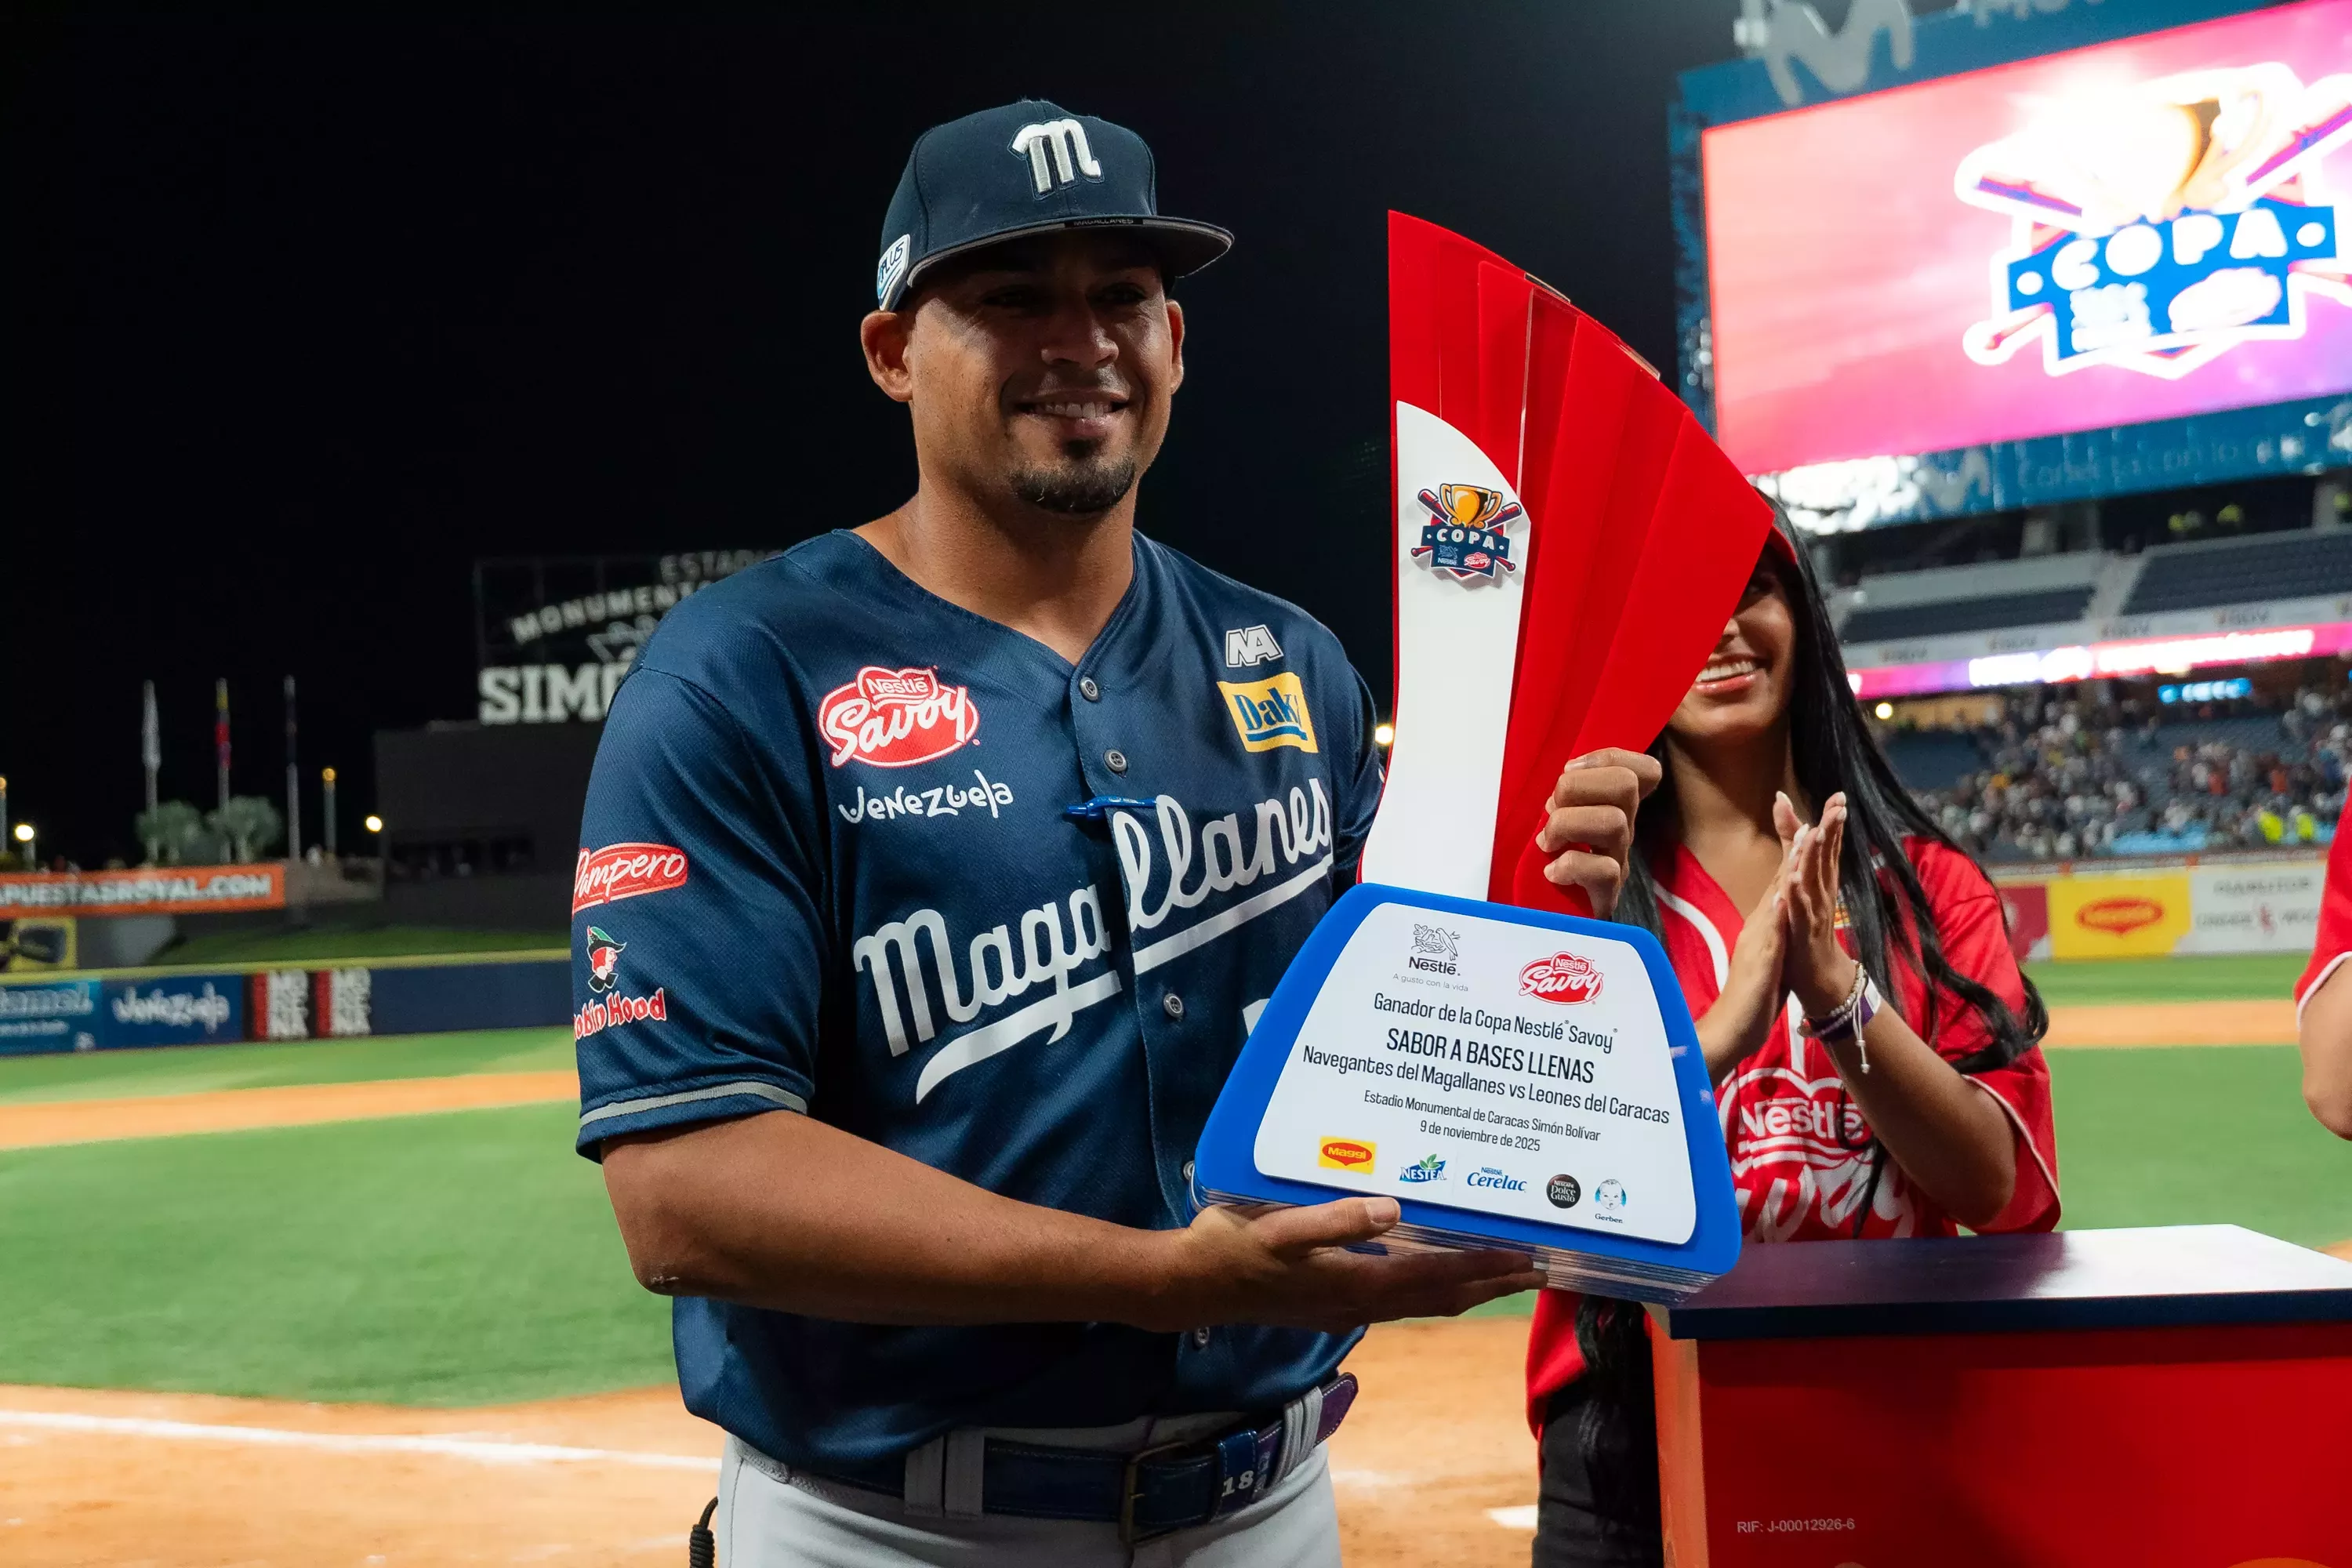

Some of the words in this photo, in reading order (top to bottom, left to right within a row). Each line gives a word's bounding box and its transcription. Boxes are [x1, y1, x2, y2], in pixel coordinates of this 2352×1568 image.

[2052, 208, 2288, 291] COPA
[1436, 528, 1494, 550] COPA
[866, 677, 928, 694] Nestlé
[1232, 688, 1301, 731] Dak
[826, 687, 967, 767] Savoy
[1409, 956, 1460, 976] Nestlé
[1401, 975, 1424, 985] gusto
[1452, 983, 1468, 992] vida
[1519, 965, 1604, 1002] Savoy
[573, 998, 607, 1041] obin
[606, 987, 666, 1026] Hood
[1374, 993, 1436, 1018] Ganador
[1439, 1004, 1456, 1022] de
[1459, 1007, 1472, 1025] la
[1475, 1010, 1511, 1035] Copa
[1387, 1028, 1446, 1058] SABOR
[1450, 1039, 1461, 1062] A
[1466, 1040, 1524, 1072] BASES
[1527, 1051, 1595, 1083] LLENAS
[1303, 1045, 1392, 1076] Navegantes
[1396, 1062, 1419, 1081] del
[1421, 1065, 1504, 1095] Magallanes
[1509, 1083, 1525, 1098] vs
[1529, 1083, 1581, 1109] Leones
[1584, 1094, 1606, 1112] del
[1609, 1097, 1670, 1124] Caracas
[1364, 1090, 1403, 1108] Estadio
[1405, 1097, 1472, 1120] Monumental
[1472, 1109, 1486, 1122] de
[1487, 1110, 1530, 1129] Caracas
[1531, 1118, 1563, 1135] Simón
[1565, 1124, 1601, 1142] Bolívar
[1420, 1120, 1428, 1133] 9
[1428, 1122, 1441, 1135] de
[1443, 1127, 1498, 1145] noviembre
[1500, 1134, 1513, 1147] de
[1515, 1136, 1541, 1152] 2025
[1327, 1146, 1367, 1159] Maggi
[1400, 1167, 1446, 1181] NESTEA
[1467, 1172, 1527, 1192] Cerelac
[1221, 1470, 1254, 1497] 18
[1737, 1521, 1763, 1533] RIF:
[1767, 1518, 1856, 1532] J-00012926-6
